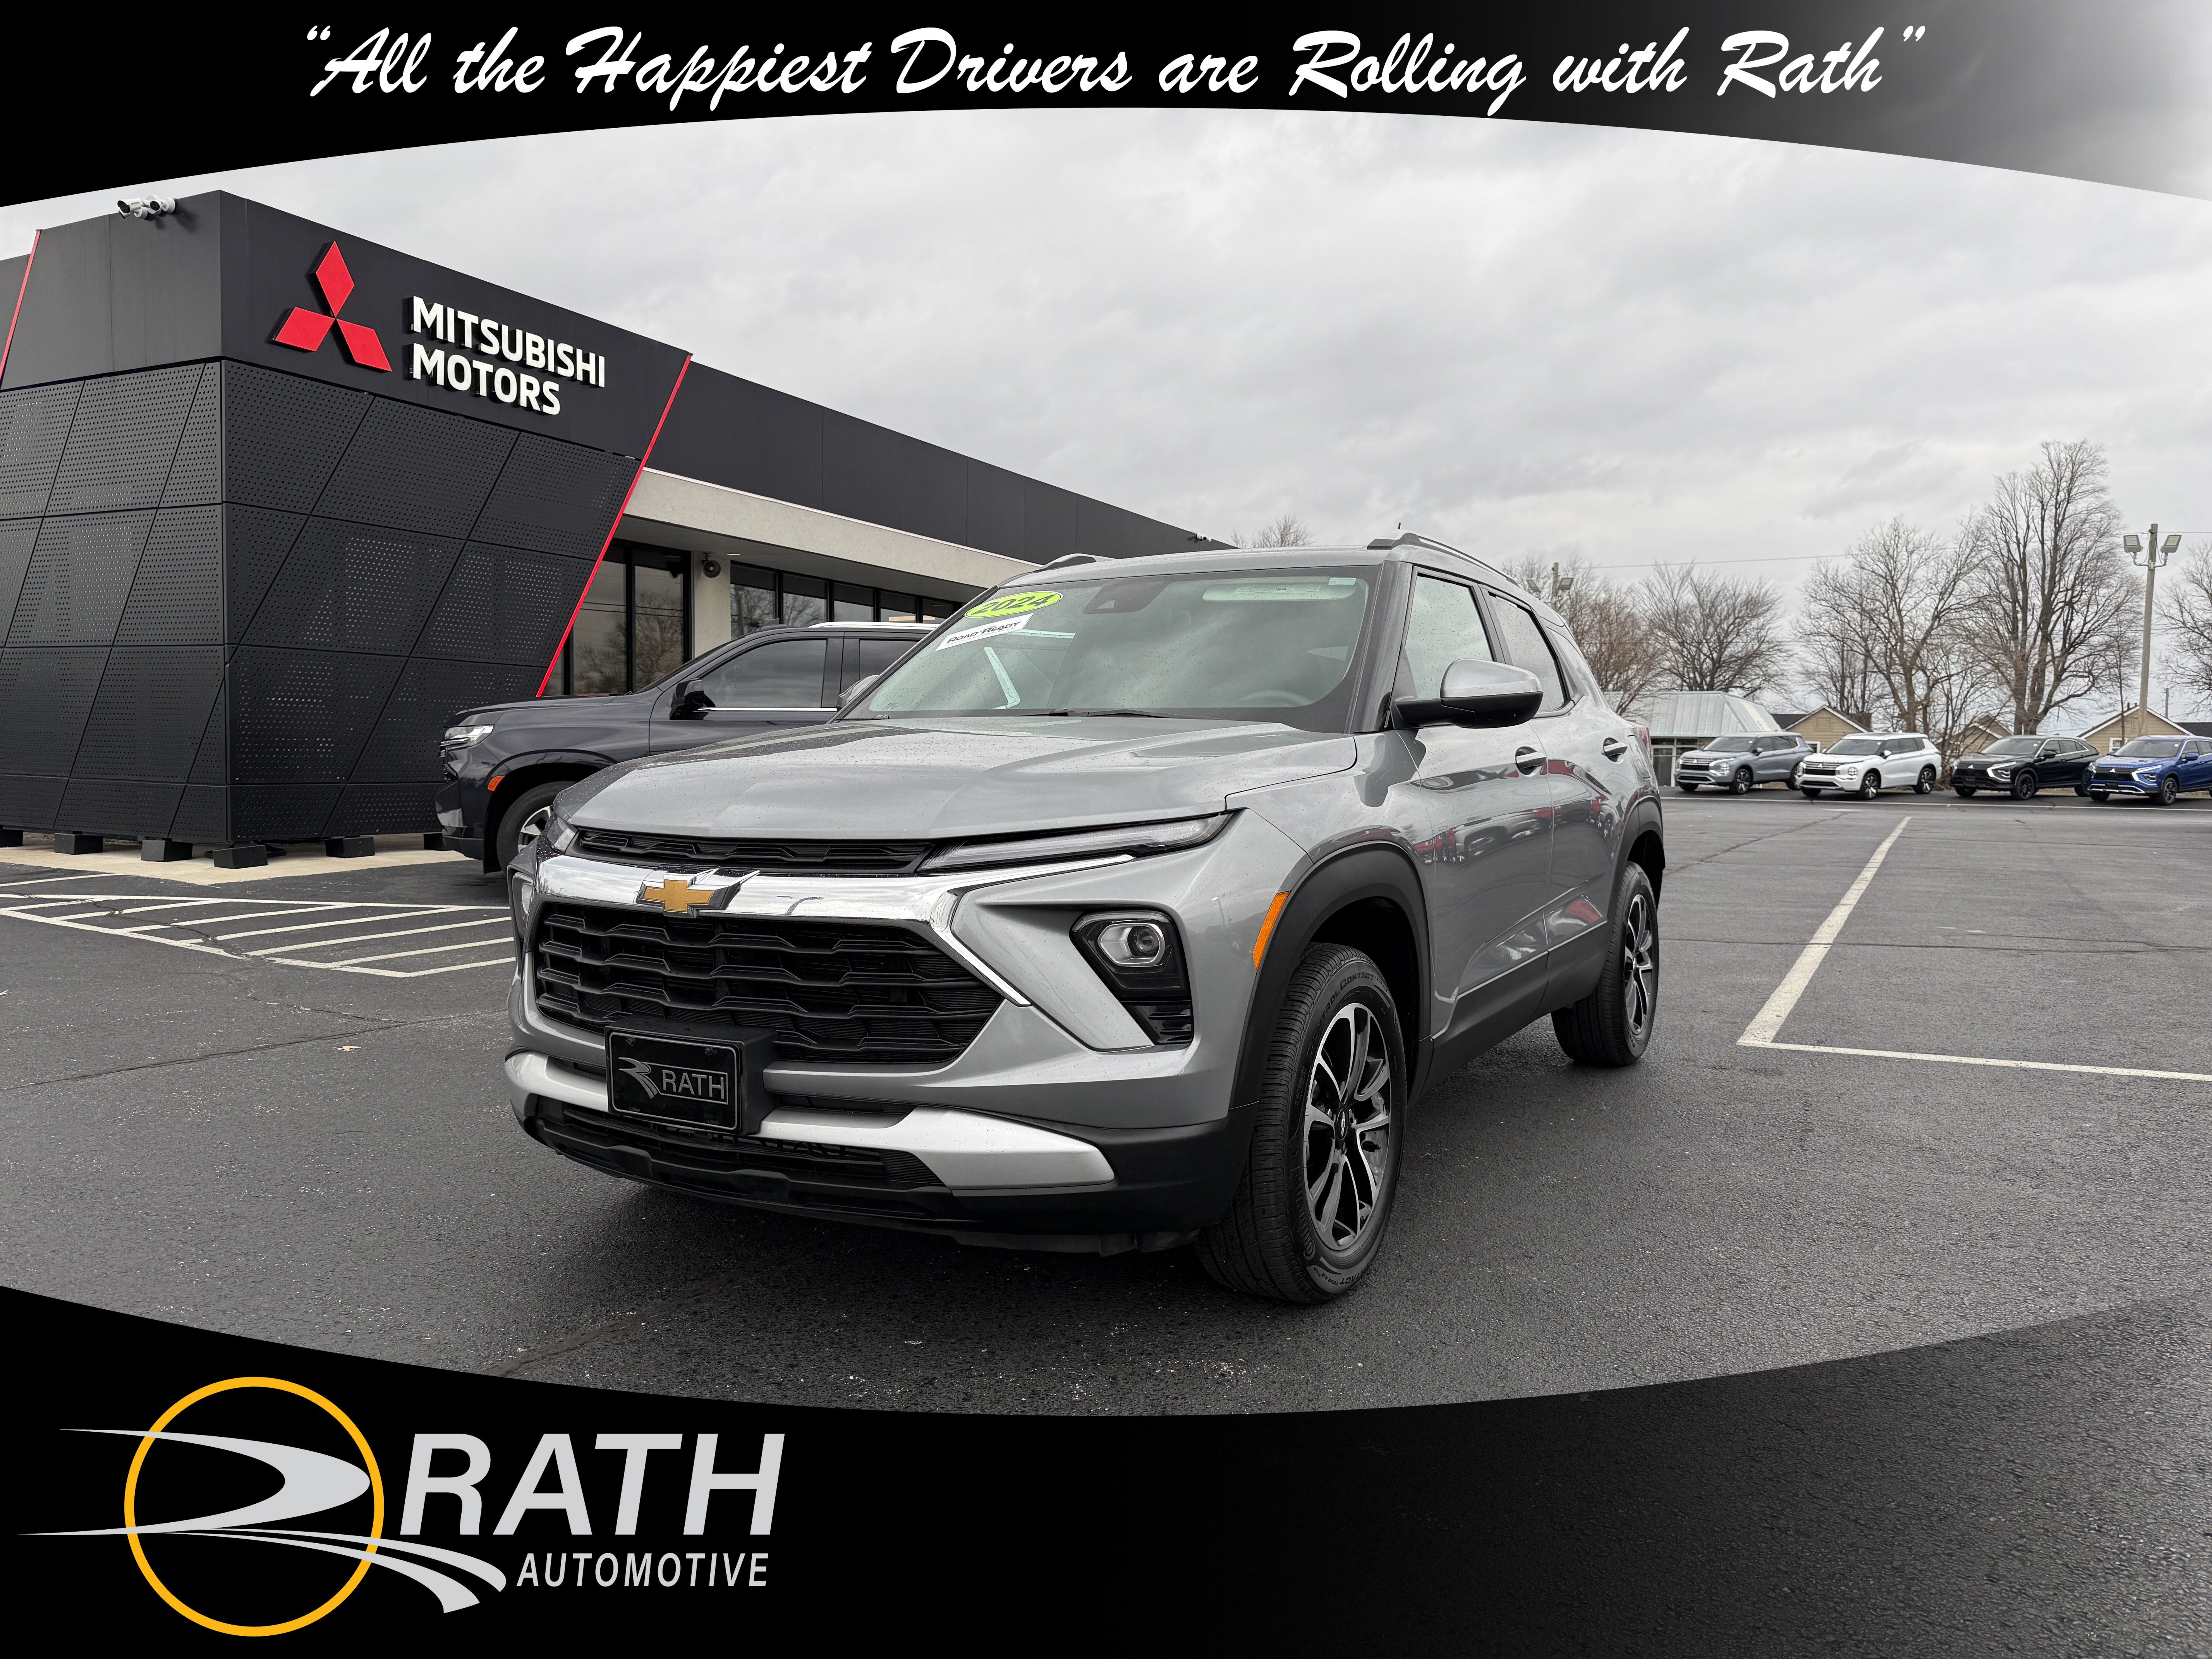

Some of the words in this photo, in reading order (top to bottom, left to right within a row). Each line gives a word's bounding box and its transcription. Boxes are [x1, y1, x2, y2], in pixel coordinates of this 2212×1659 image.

[414, 296, 605, 387] MITSUBISHI
[414, 343, 560, 414] MOTORS
[970, 594, 1056, 616] 2024
[662, 1070, 724, 1099] RATH
